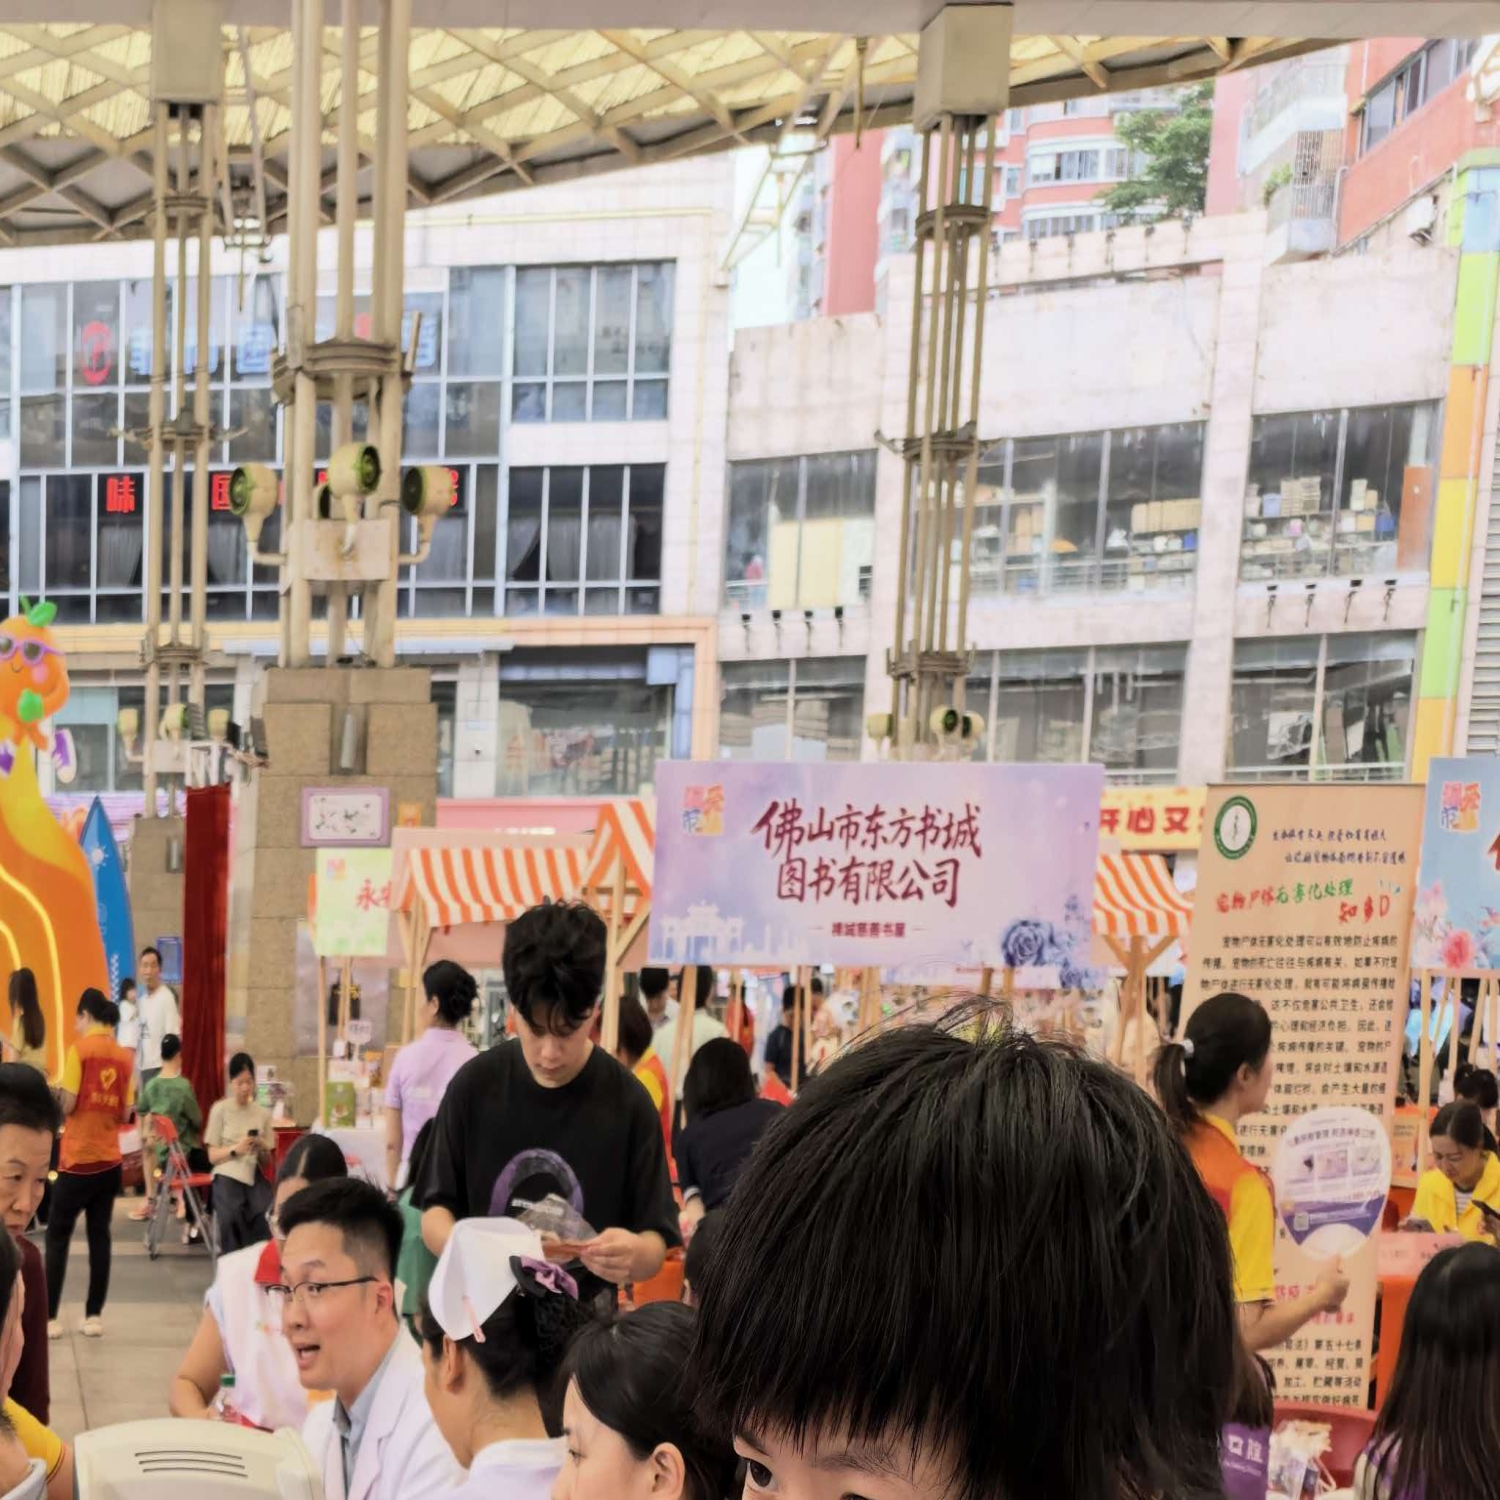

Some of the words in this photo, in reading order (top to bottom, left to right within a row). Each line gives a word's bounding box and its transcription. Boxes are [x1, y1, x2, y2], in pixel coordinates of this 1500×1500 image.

[106, 475, 135, 513] 味
[751, 798, 983, 859] 佛山市东方书城
[777, 856, 960, 908] 图书有限公司
